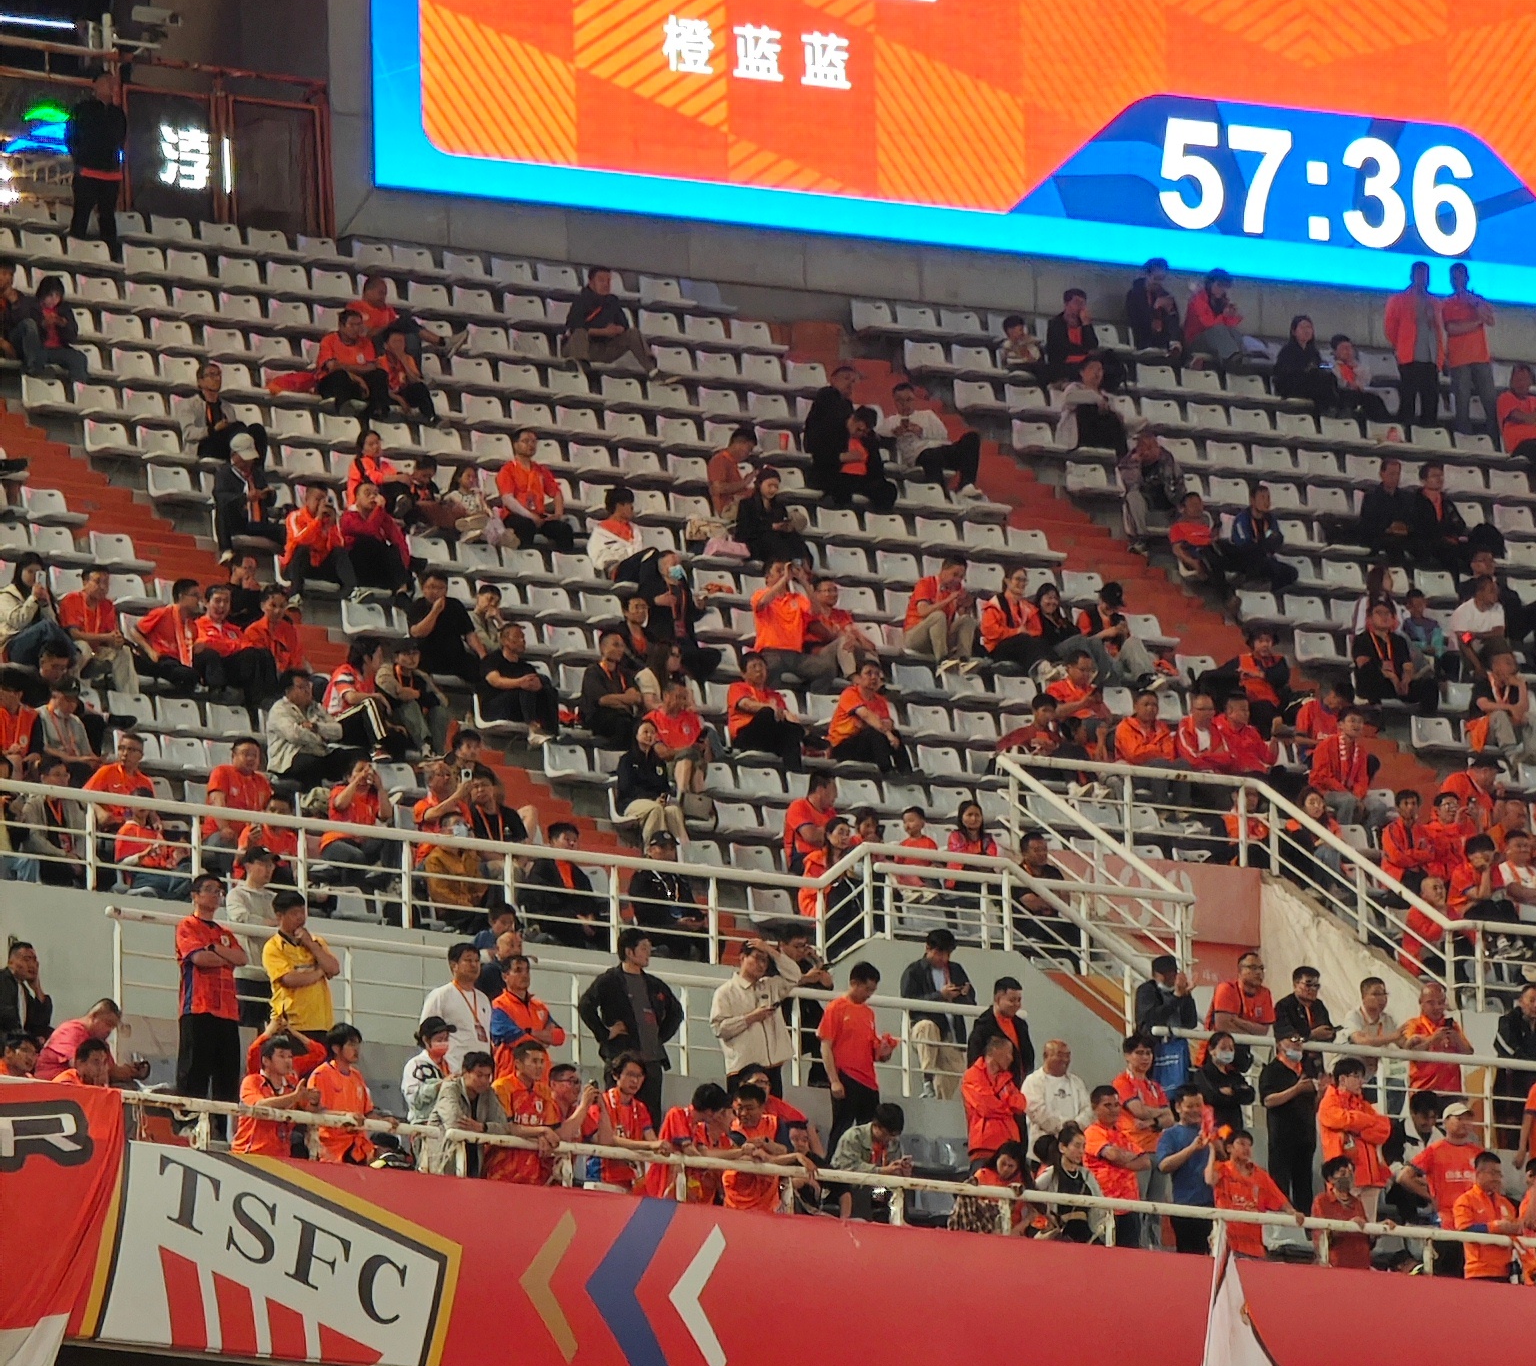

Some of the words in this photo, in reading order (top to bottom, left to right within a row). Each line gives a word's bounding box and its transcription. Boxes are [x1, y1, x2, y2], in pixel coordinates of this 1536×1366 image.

[662, 15, 713, 74] 橙
[733, 25, 783, 82] 蓝
[801, 32, 851, 89] 蓝
[1159, 117, 1477, 256] 57:36
[158, 1154, 408, 1324] TSFC
